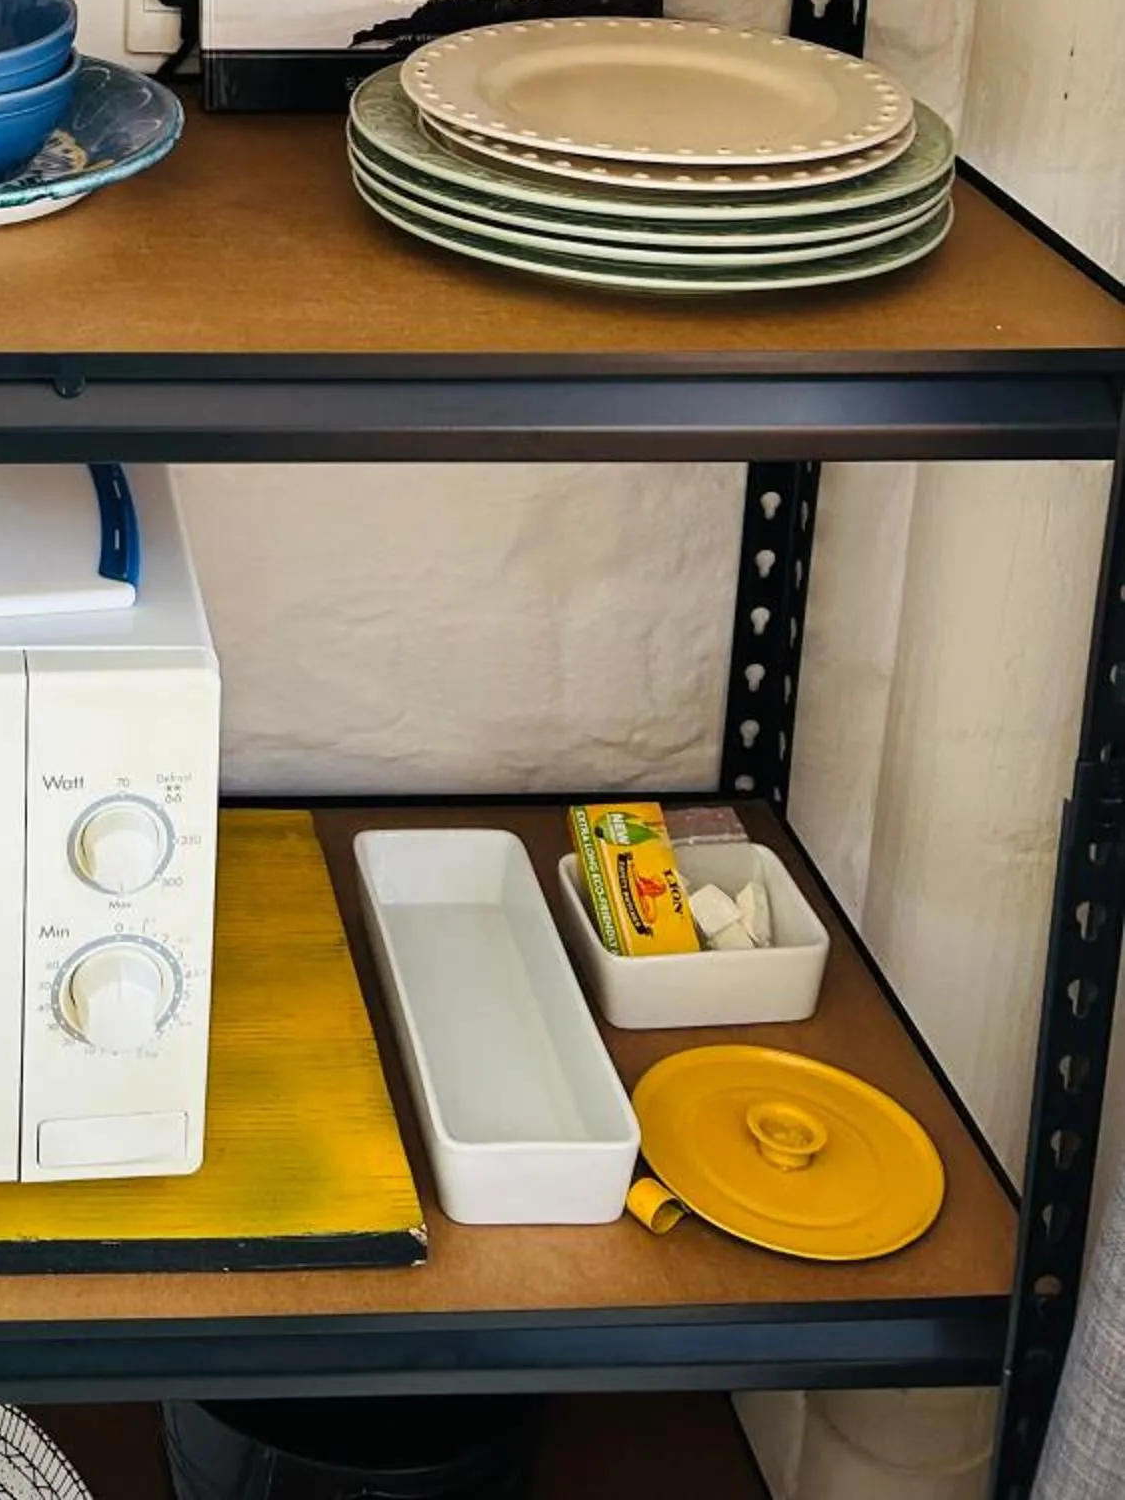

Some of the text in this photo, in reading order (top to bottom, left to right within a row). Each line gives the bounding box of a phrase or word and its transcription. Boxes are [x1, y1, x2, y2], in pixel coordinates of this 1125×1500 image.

[42, 775, 85, 791] Watt
[609, 813, 631, 846] NEW
[663, 868, 684, 915] LION
[39, 925, 70, 939] Min
